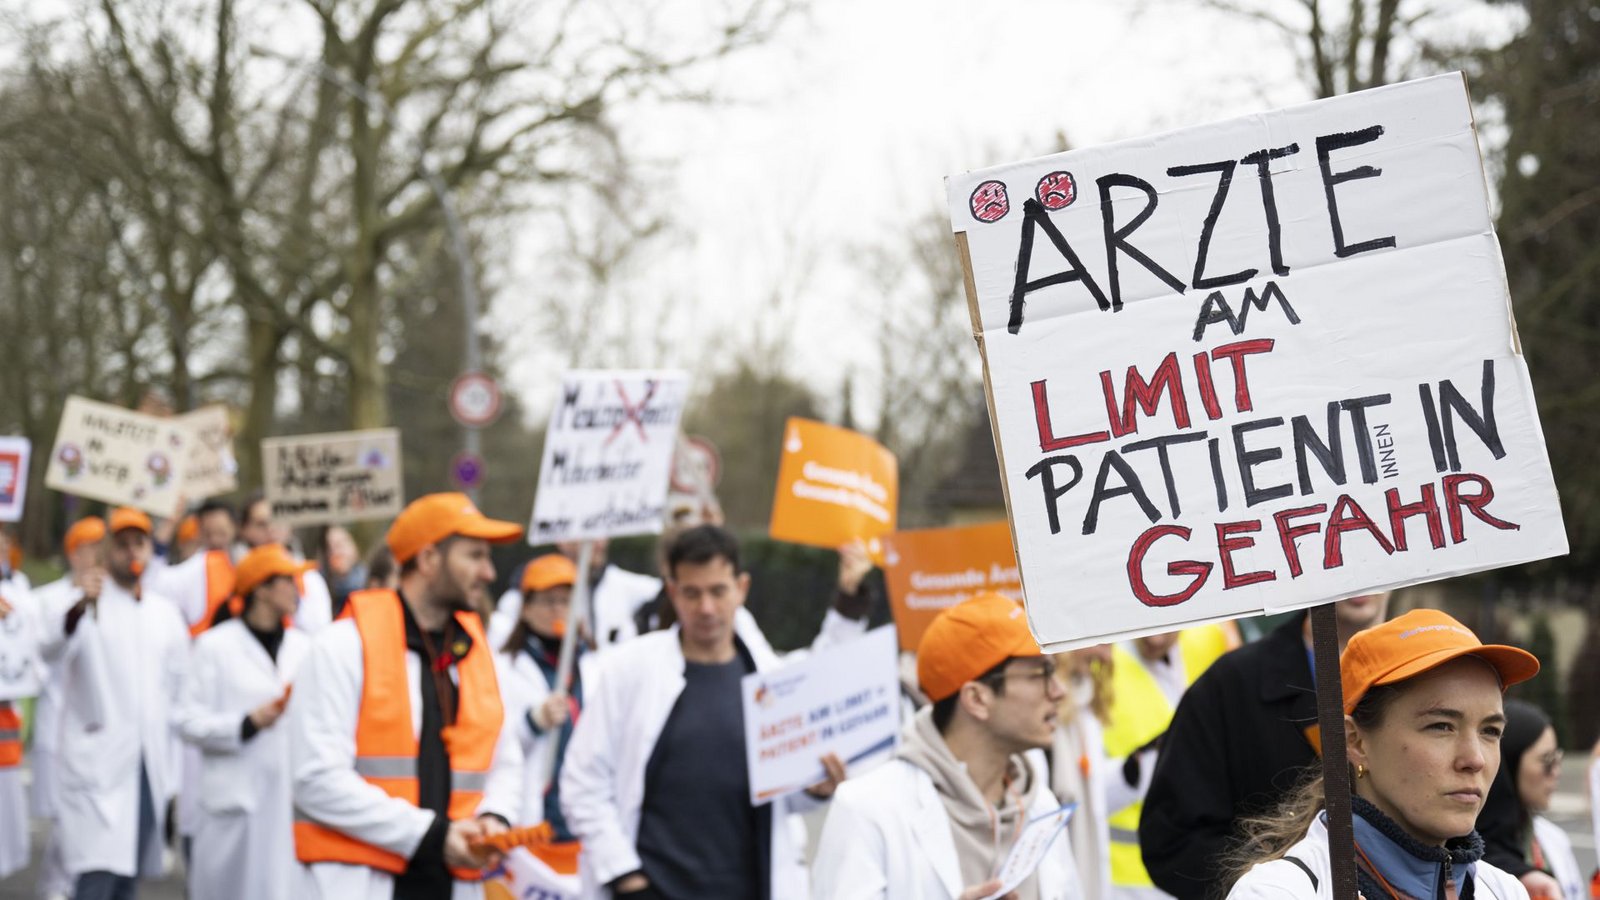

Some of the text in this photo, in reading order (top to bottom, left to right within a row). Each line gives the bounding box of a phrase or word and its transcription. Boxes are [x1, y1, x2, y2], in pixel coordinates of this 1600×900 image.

[1193, 281, 1301, 341] AM
[1026, 360, 1506, 535] PATIENT INNEN IN
[1030, 339, 1275, 453] LIMIT
[1126, 472, 1521, 607] GEFAHR
